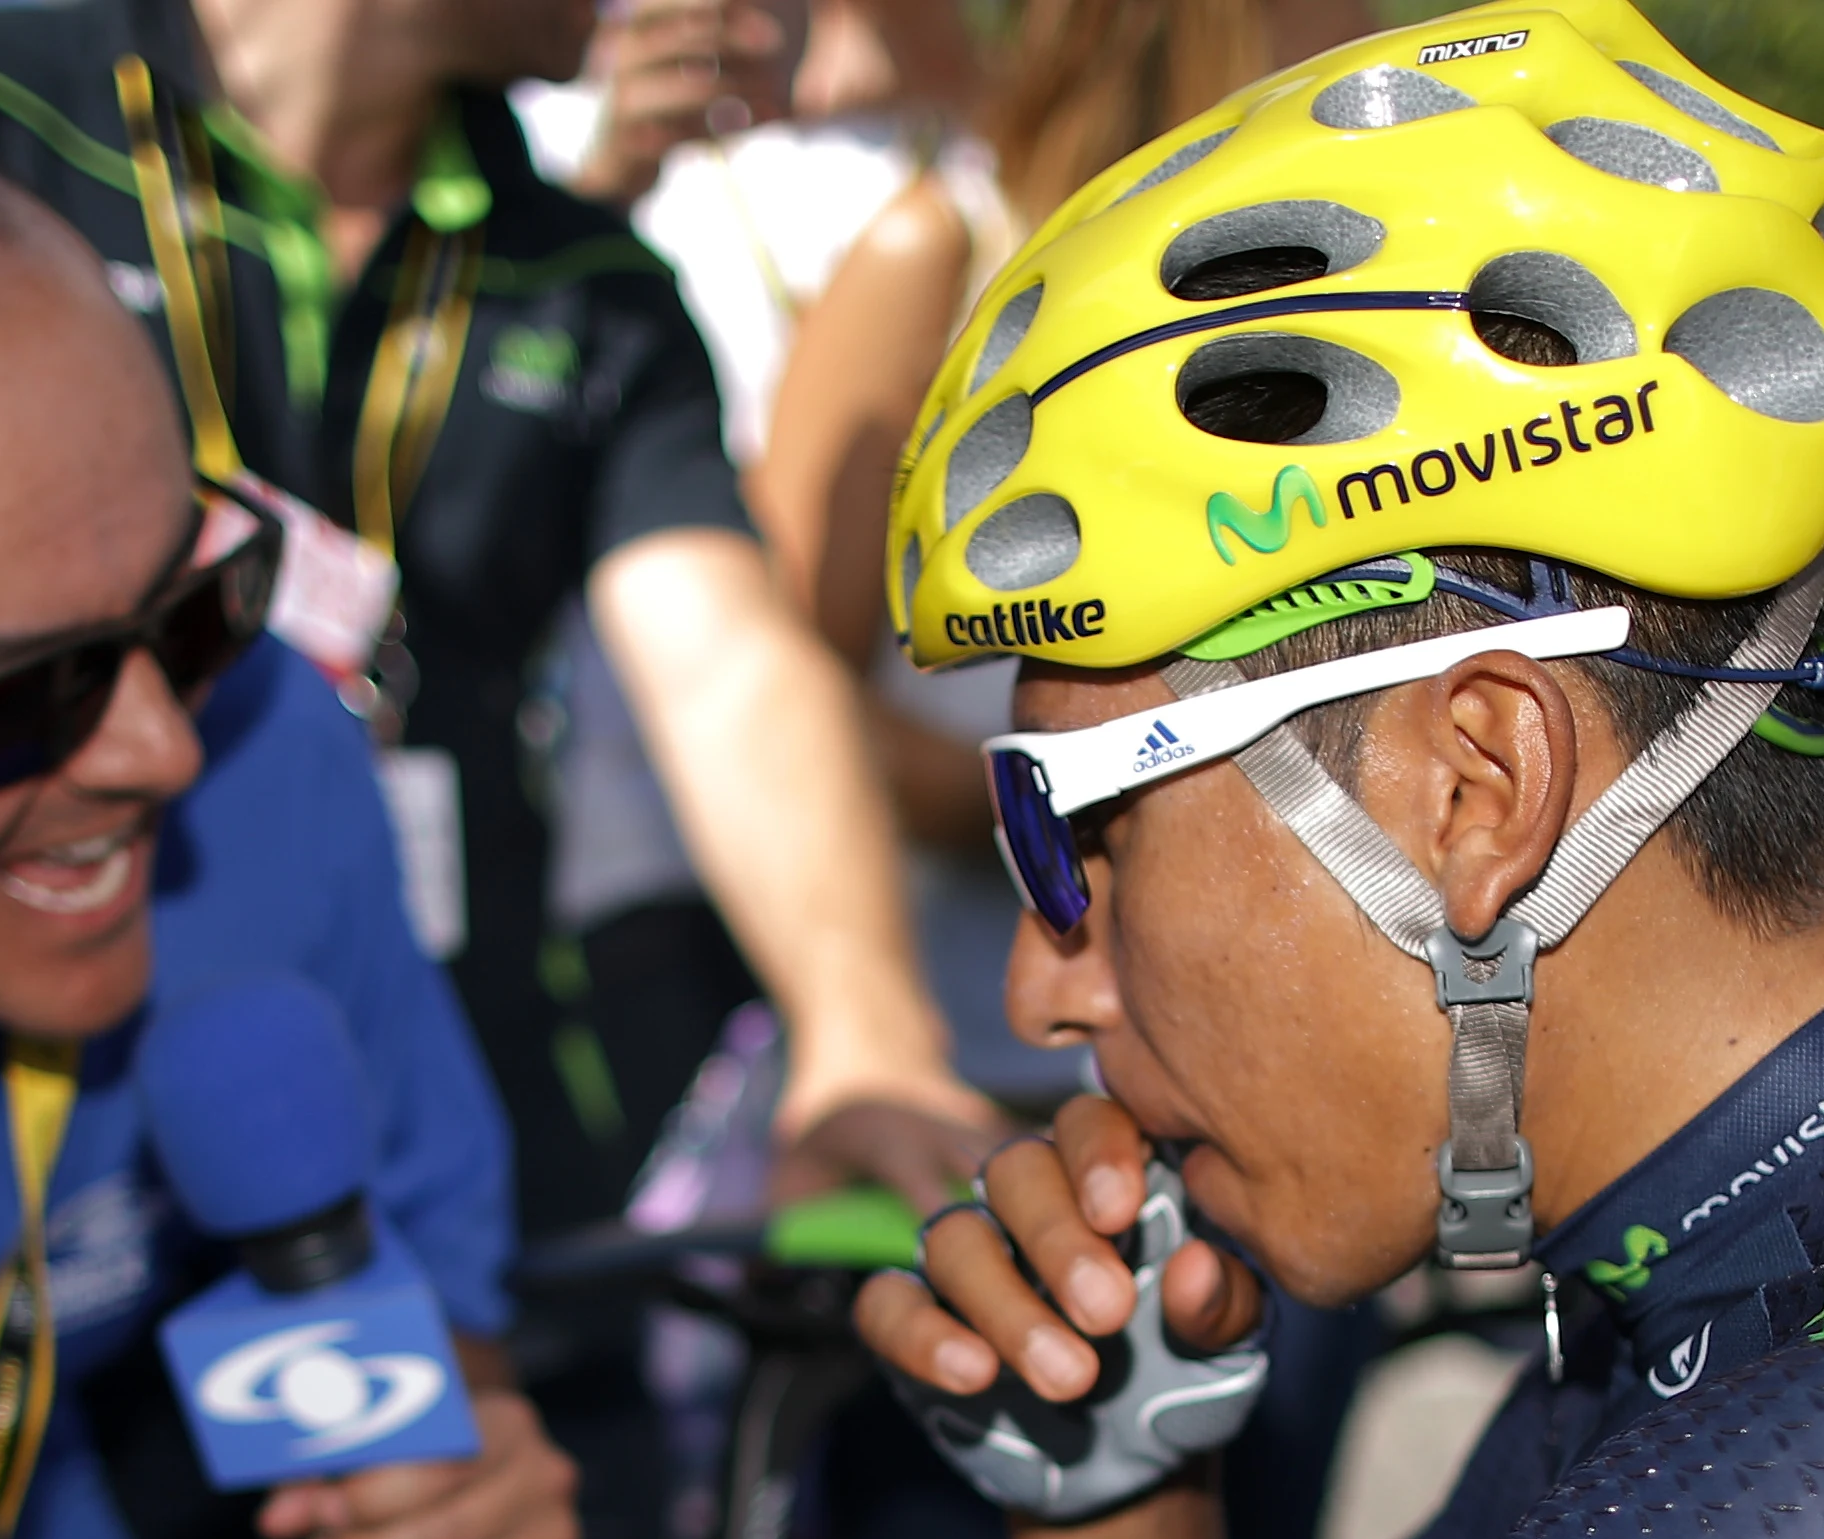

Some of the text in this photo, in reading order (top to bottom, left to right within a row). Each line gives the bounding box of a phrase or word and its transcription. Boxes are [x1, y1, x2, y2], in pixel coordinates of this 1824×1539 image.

[1337, 380, 1658, 520] movistar
[945, 598, 1106, 647] catlike
[1133, 744, 1196, 773] adidas
